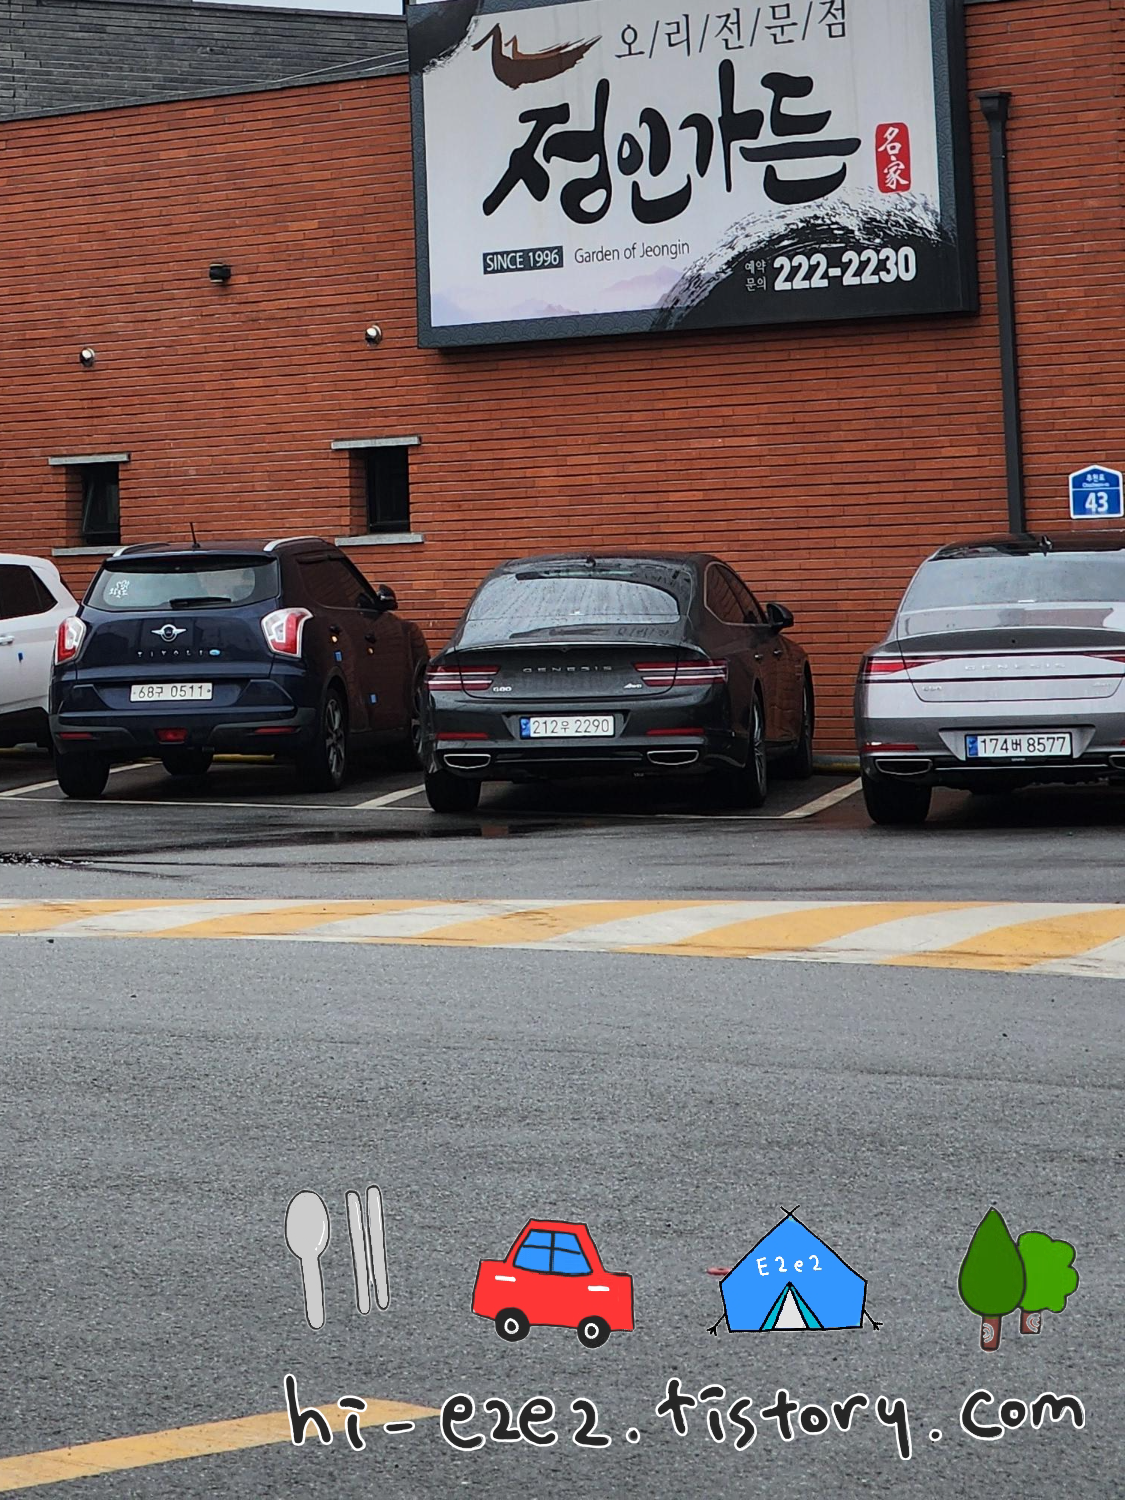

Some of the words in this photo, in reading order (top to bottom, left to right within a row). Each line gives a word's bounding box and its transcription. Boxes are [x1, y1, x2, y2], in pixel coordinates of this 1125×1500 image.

[483, 58, 862, 224] 정인가든
[877, 126, 910, 190] 名家
[486, 251, 524, 271] SINCE
[528, 249, 560, 267] 1996
[574, 245, 620, 264] Garden
[624, 241, 637, 260] of
[640, 239, 690, 259] Jeongin
[744, 259, 767, 275] 예약
[773, 246, 917, 291] 222-2230
[745, 276, 767, 292] 문의
[1085, 491, 1109, 513] 43
[138, 686, 164, 699] 68구
[170, 685, 204, 698] 0511
[532, 719, 570, 734] 212우
[574, 718, 610, 733] 2290
[980, 737, 1022, 755] 174버
[1026, 736, 1067, 753] 8577
